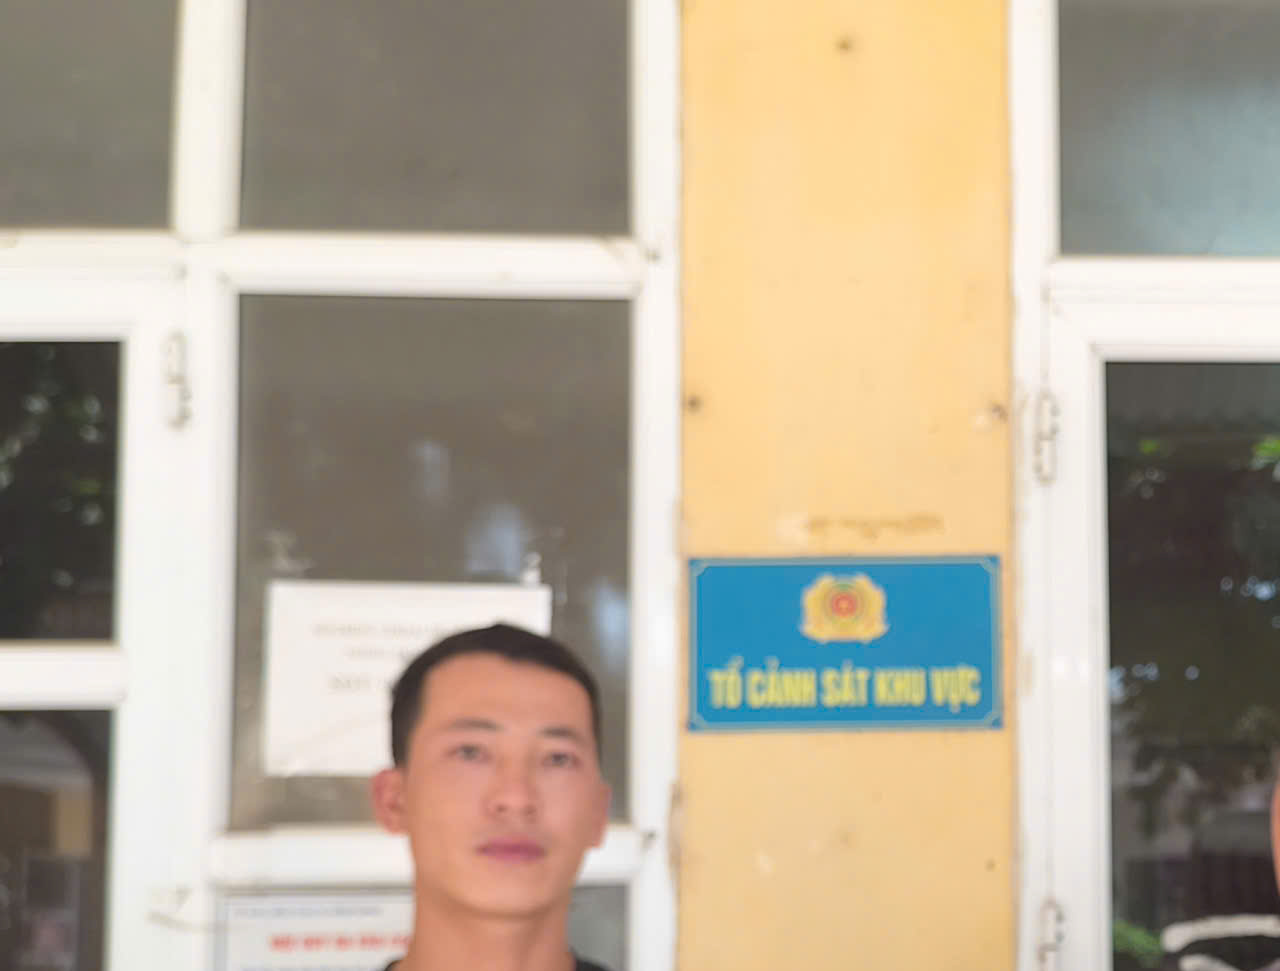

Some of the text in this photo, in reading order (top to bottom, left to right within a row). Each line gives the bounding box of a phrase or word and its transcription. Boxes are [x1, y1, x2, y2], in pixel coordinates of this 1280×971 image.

[746, 656, 817, 707] CẢNH
[821, 659, 869, 706] SÁT
[874, 667, 926, 706] KHU
